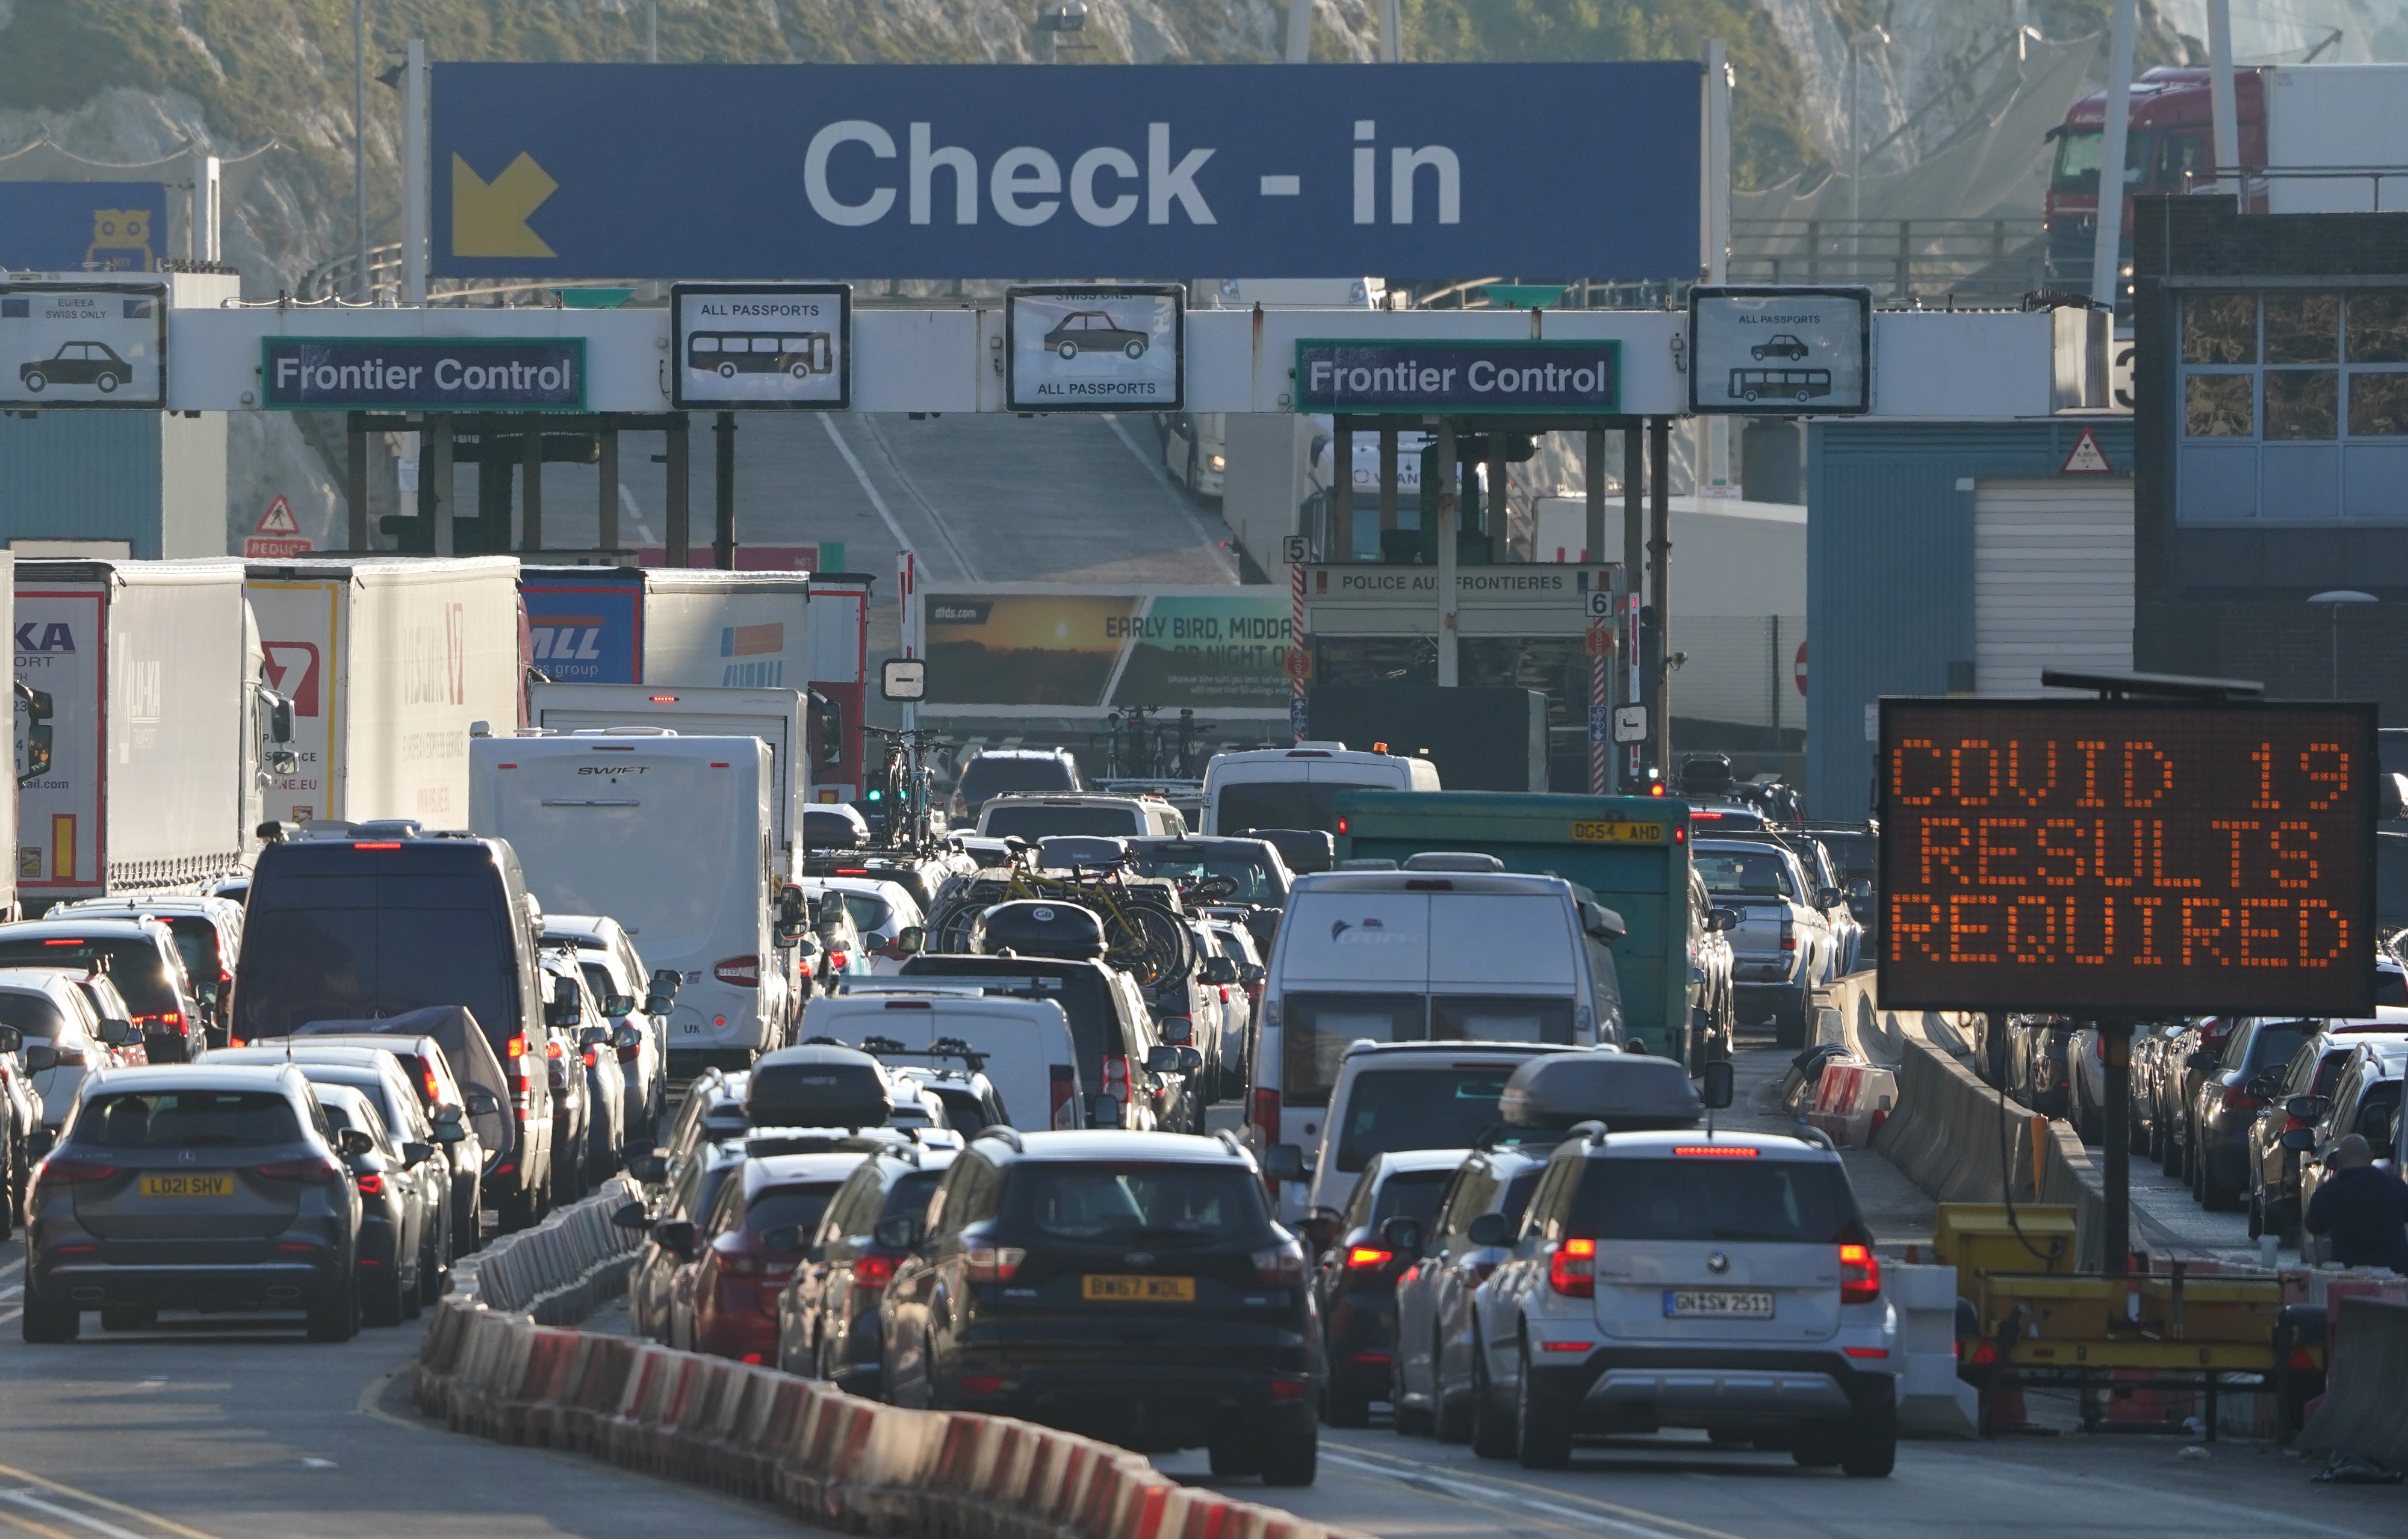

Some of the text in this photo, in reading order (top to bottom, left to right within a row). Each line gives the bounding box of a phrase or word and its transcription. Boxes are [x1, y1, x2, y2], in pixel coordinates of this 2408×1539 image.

[804, 120, 1460, 227] Check - in
[701, 305, 819, 316] ALL PASSPORTS
[1761, 315, 1820, 324] PASSPORTS
[278, 358, 569, 390] Frontier Control
[1310, 361, 1604, 392] Frontier Control
[1037, 383, 1156, 394] ALL PASSPORTS
[1290, 540, 1305, 560] 5
[1342, 576, 1406, 589] POLICE
[935, 607, 976, 618] dfds.com
[1592, 594, 1607, 613] 6
[1106, 617, 1167, 639] EARLY
[1174, 618, 1223, 642] BIRD,
[1207, 645, 1267, 666] NIGHT
[556, 665, 598, 678] group
[1893, 739, 2349, 809] COVID 19
[1922, 818, 2318, 888] RESULTS
[1892, 894, 2348, 967] REQUIRED
[684, 1024, 700, 1033] UK
[191, 1178, 223, 1194] SHV
